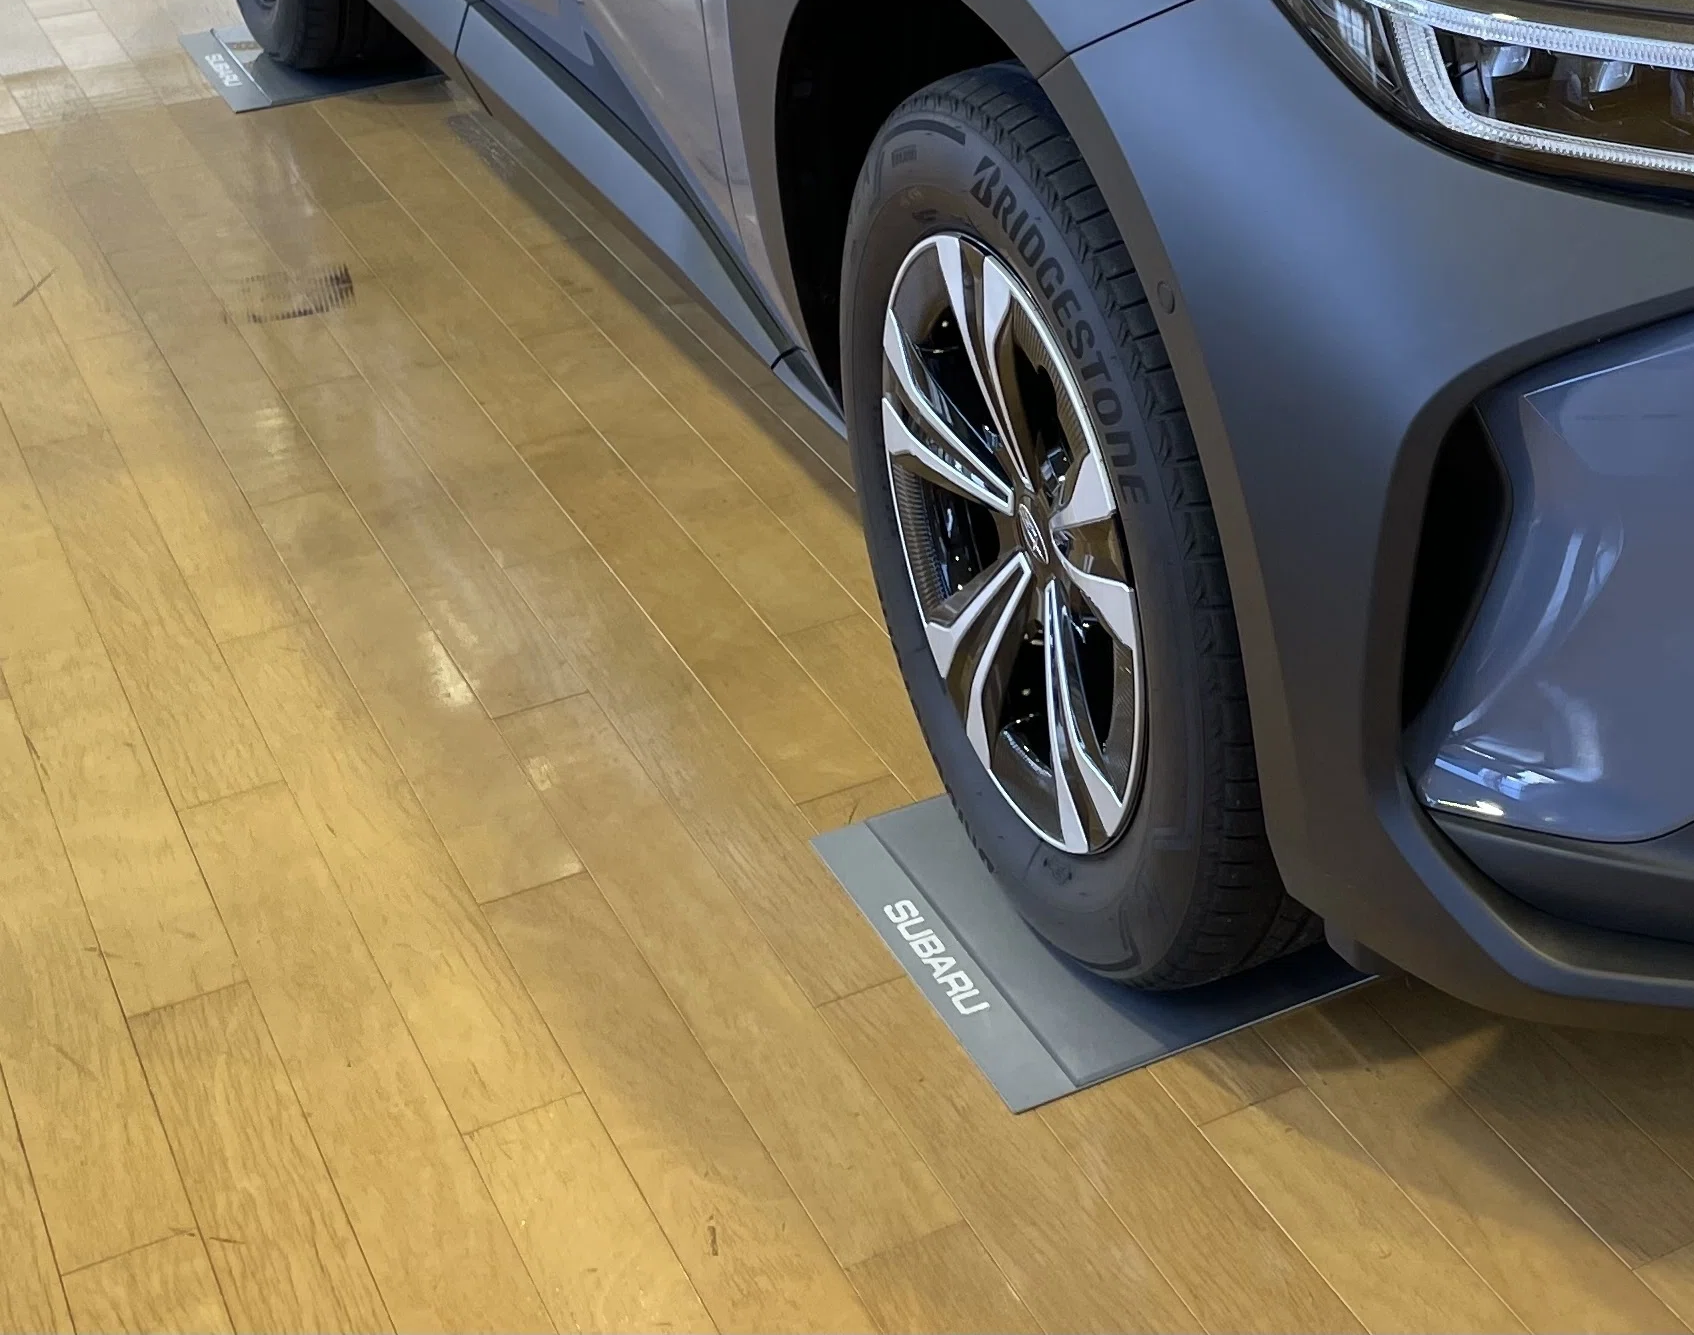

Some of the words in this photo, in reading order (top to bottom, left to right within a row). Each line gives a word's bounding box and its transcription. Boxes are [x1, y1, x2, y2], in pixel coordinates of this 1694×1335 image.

[204, 52, 243, 88] SUBARU
[969, 155, 1151, 506] BRIDGESTONE
[883, 899, 991, 1015] SUBARU
